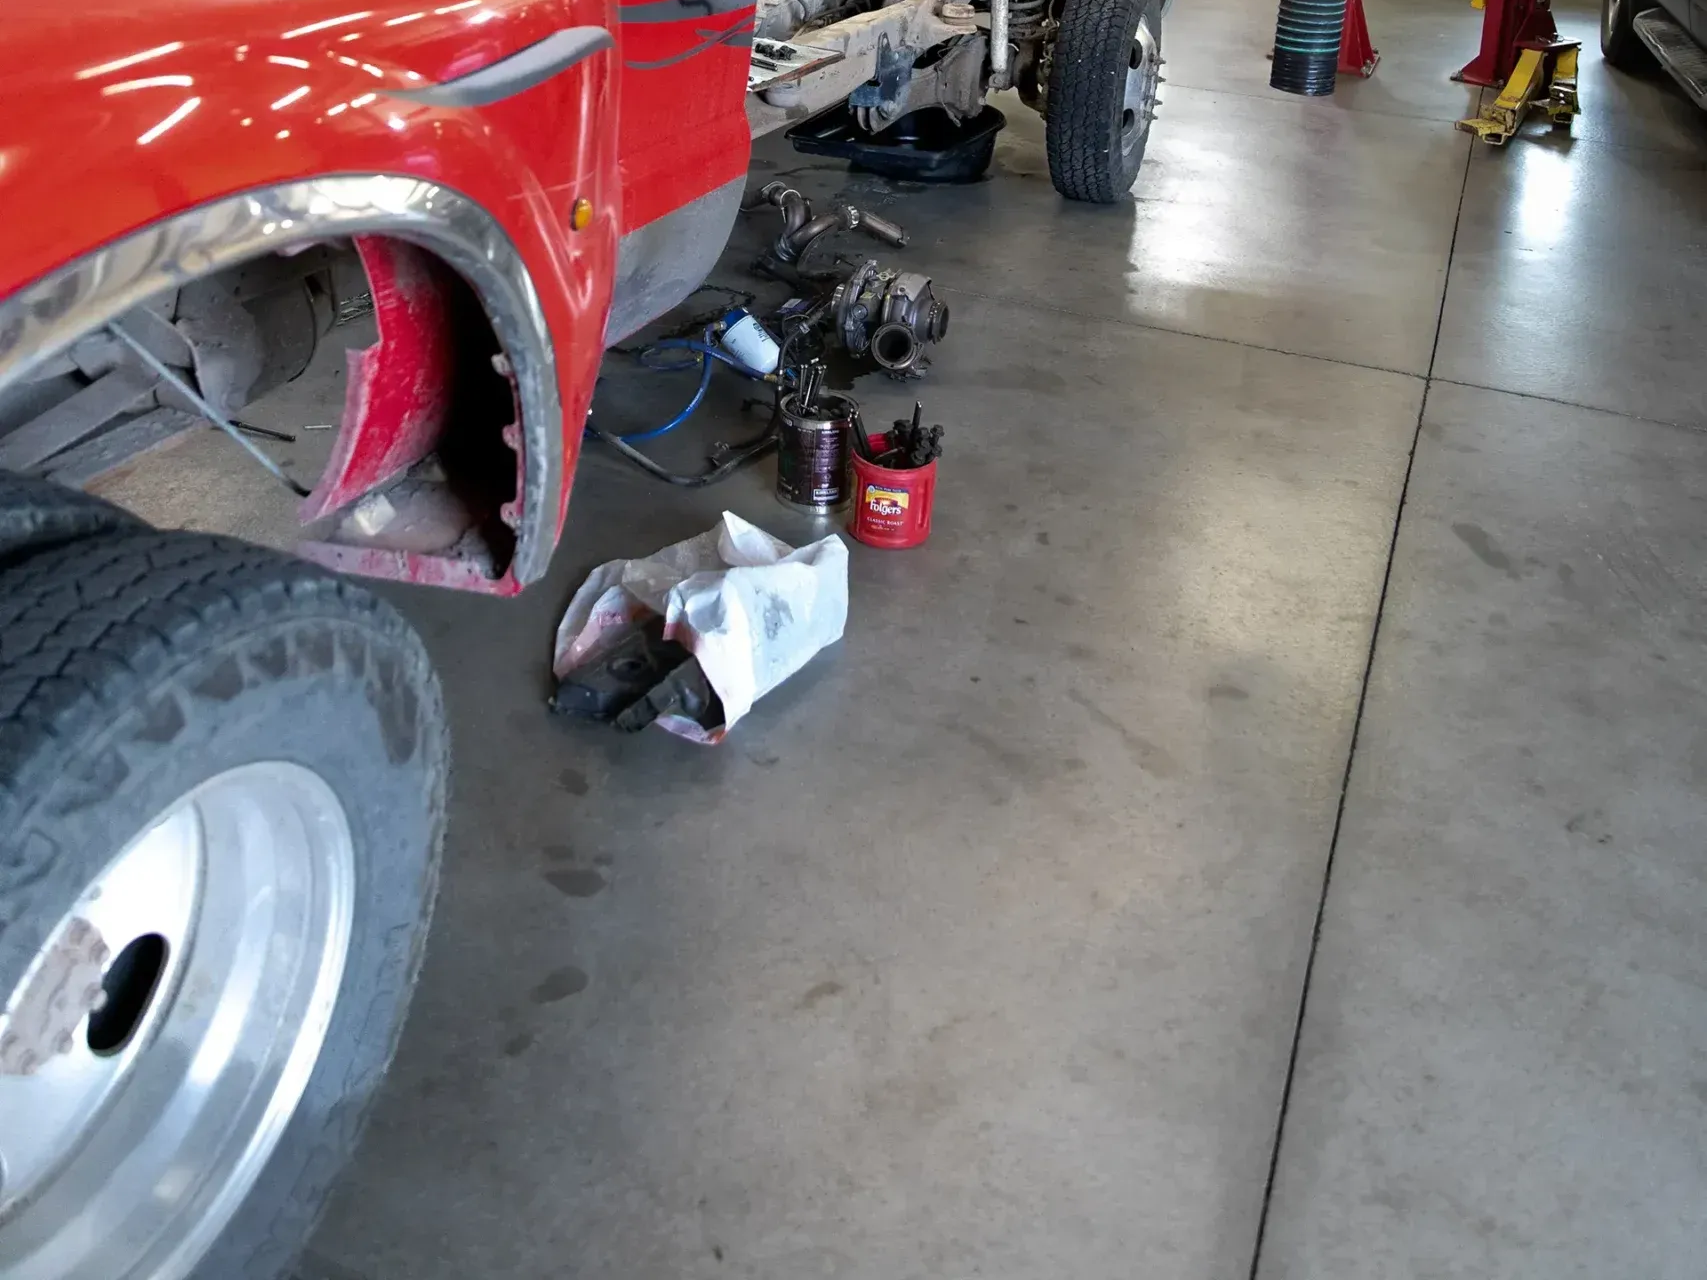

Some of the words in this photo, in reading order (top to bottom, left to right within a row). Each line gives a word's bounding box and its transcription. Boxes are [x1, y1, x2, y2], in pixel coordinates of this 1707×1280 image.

[870, 499, 902, 515] Folgers
[866, 516, 886, 525] CLASSIC
[886, 519, 904, 527] ROAST
